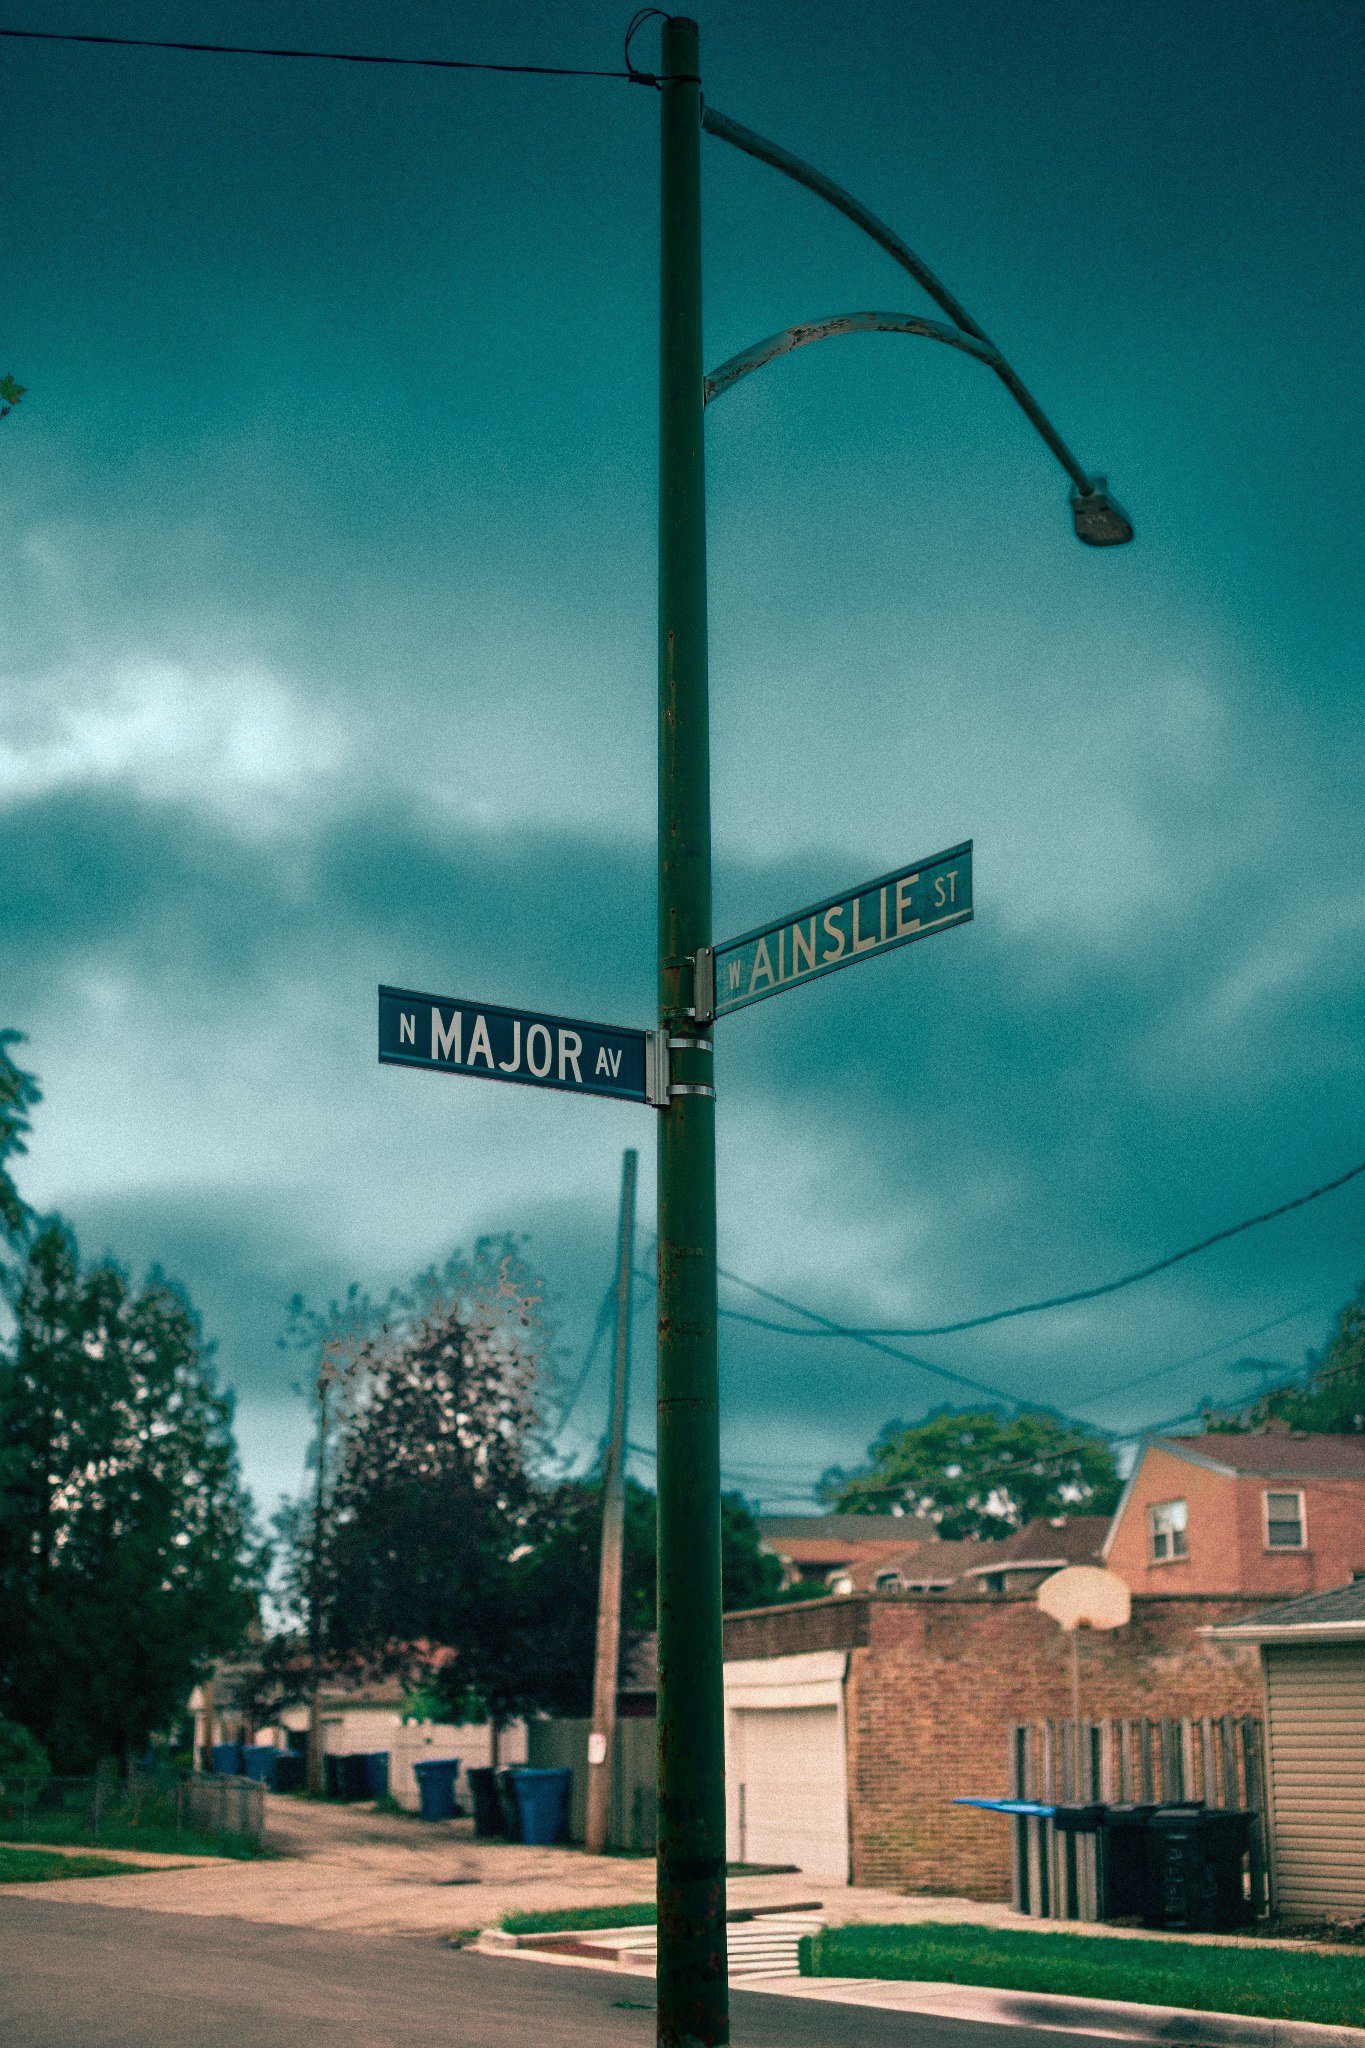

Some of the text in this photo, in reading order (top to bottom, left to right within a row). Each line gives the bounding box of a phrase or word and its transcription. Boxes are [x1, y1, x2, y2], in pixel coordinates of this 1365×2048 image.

[728, 871, 958, 995] W AINSLIE ST
[400, 1007, 622, 1083] N MAJOR AV
